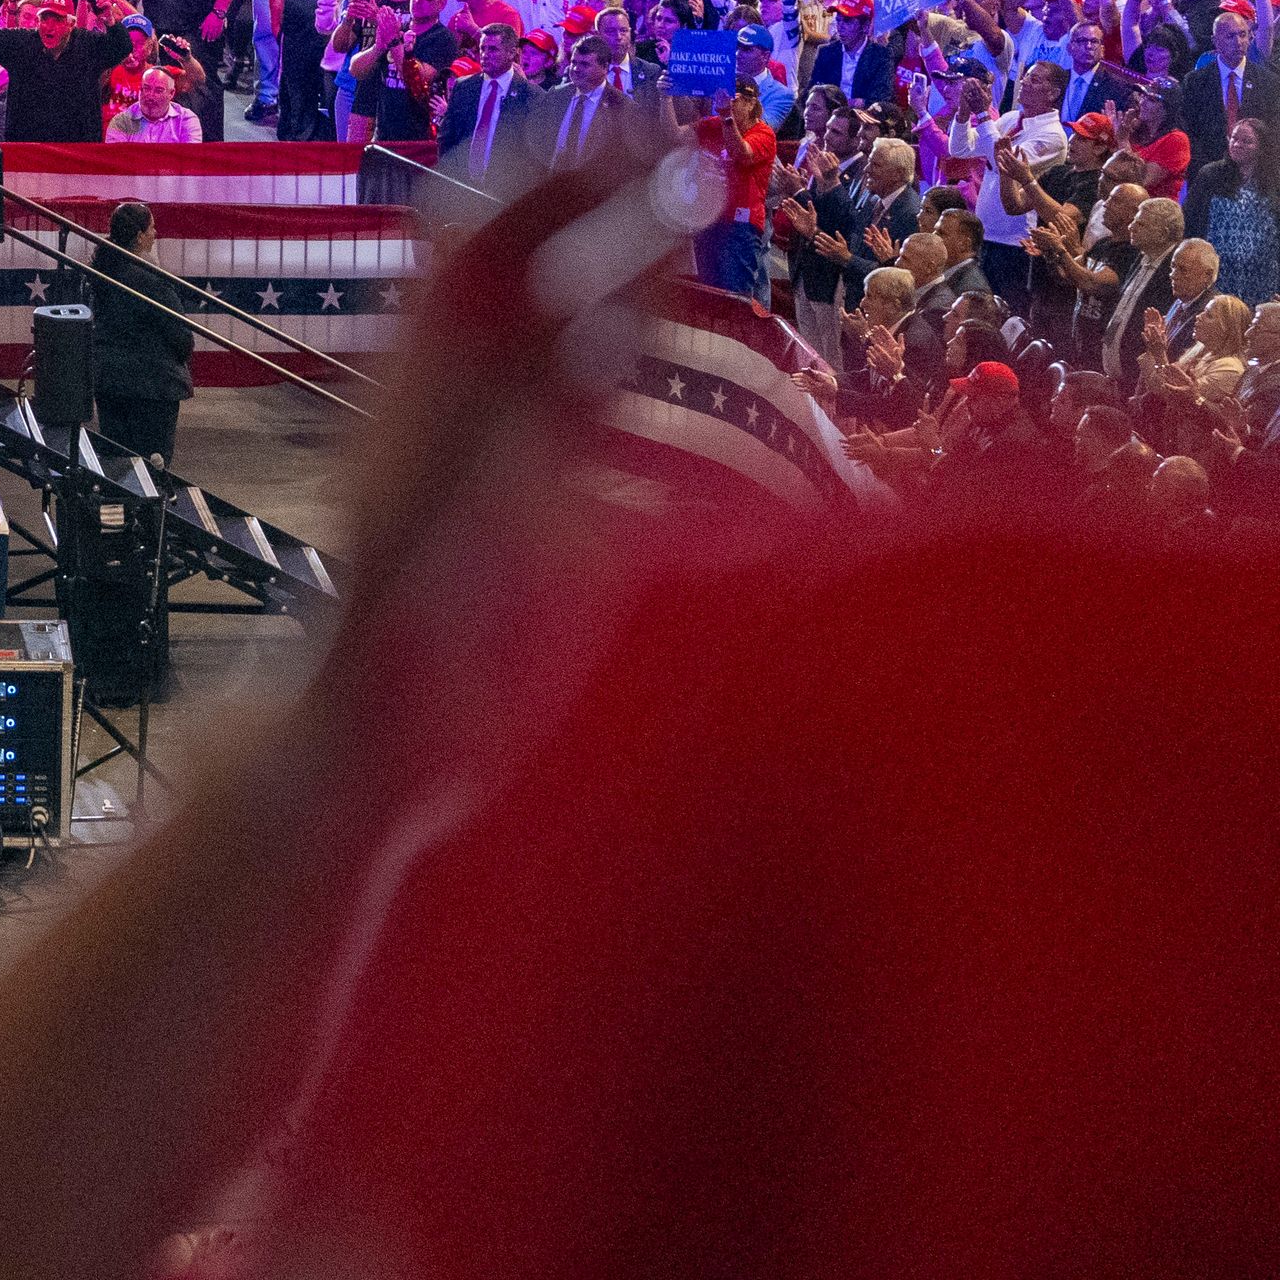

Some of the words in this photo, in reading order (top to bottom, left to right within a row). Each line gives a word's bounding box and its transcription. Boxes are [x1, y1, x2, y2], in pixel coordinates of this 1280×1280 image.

[691, 52, 731, 64] AMERICA
[671, 63, 694, 74] GREAT
[694, 65, 725, 76] AGAIN
